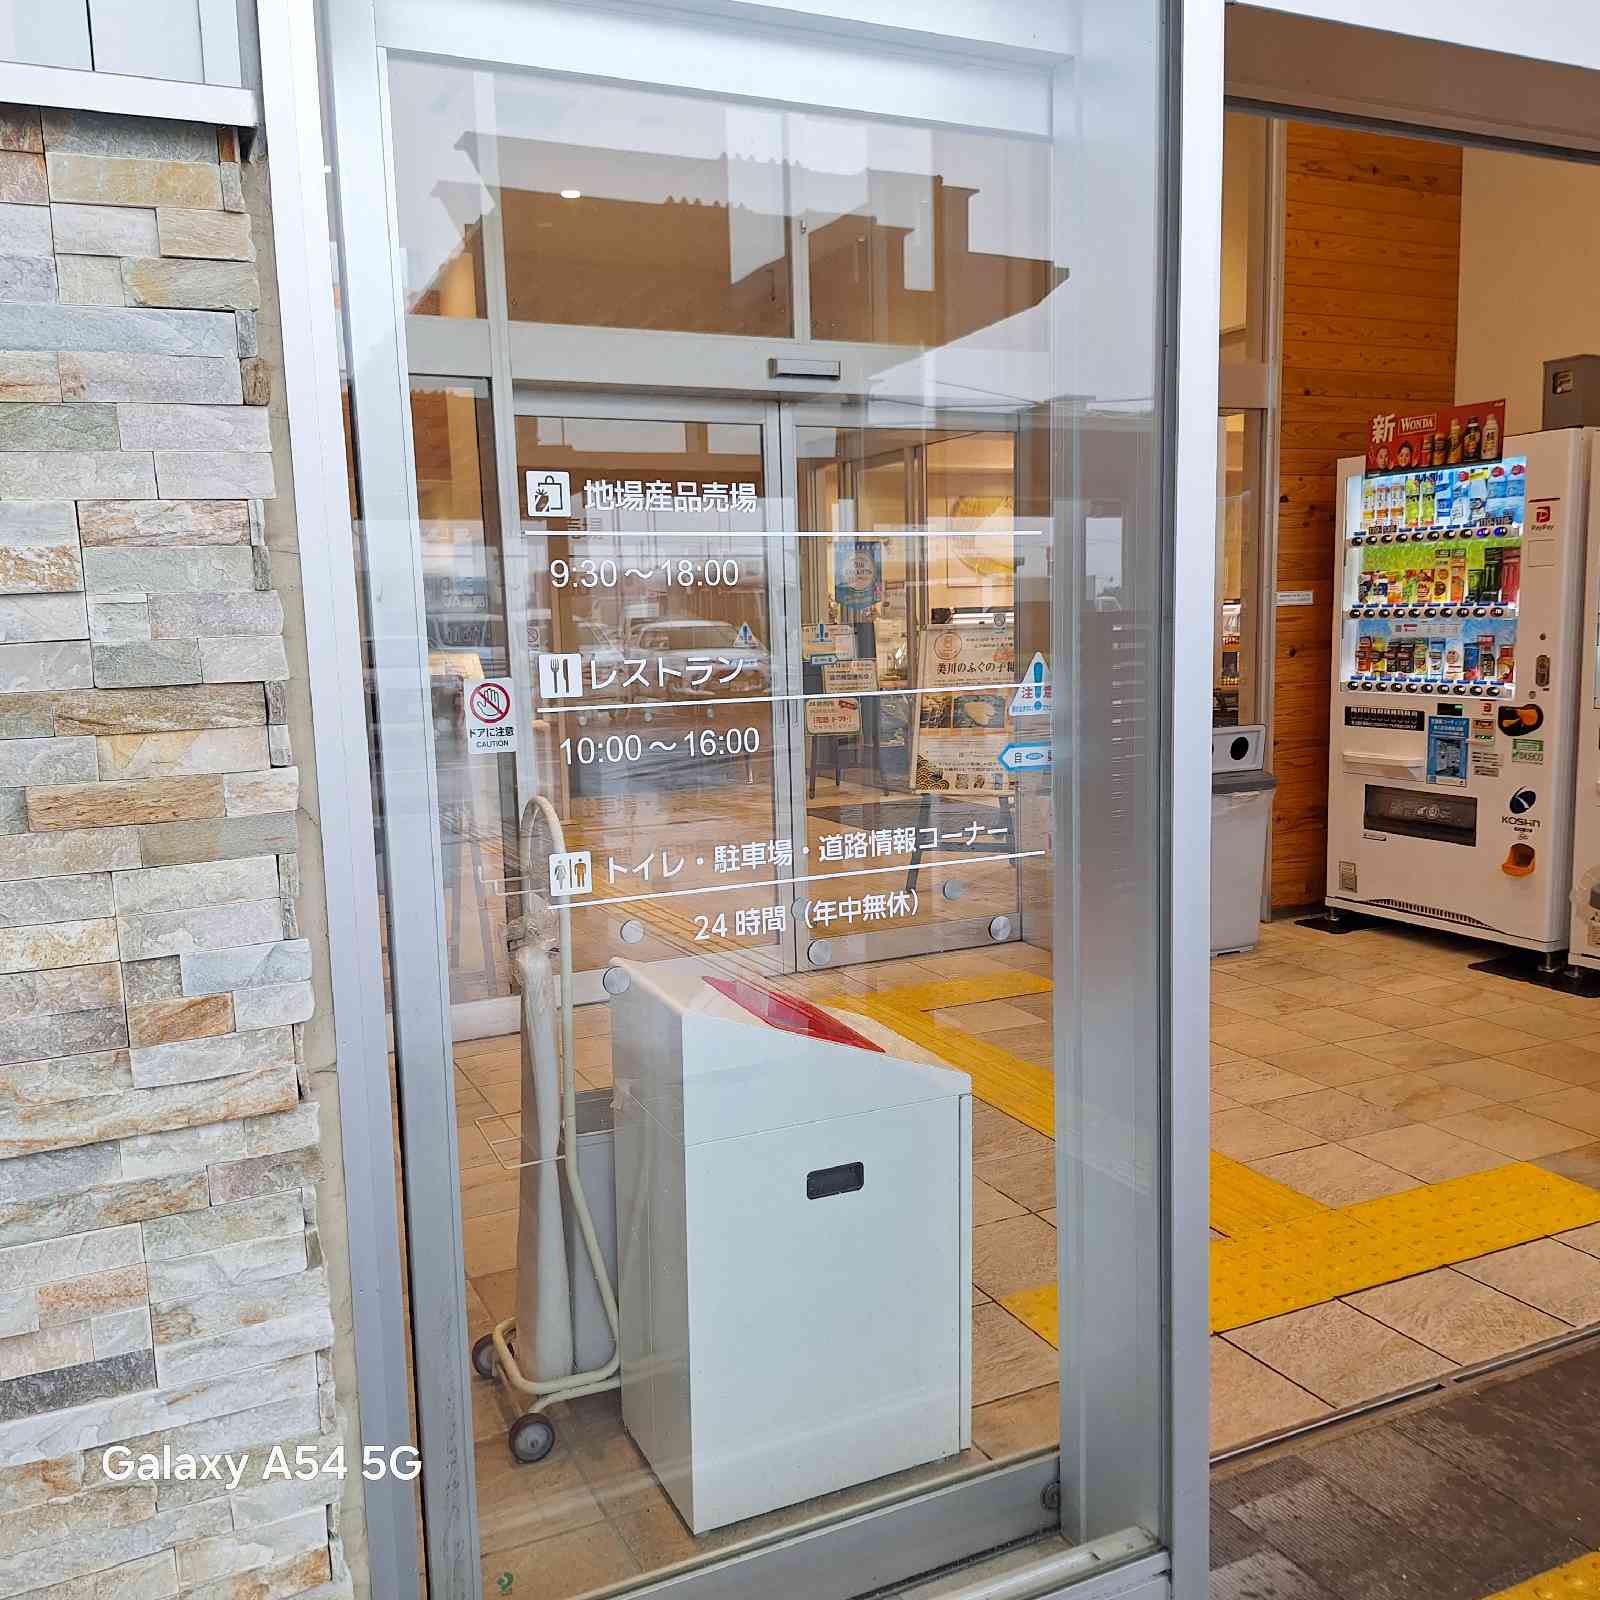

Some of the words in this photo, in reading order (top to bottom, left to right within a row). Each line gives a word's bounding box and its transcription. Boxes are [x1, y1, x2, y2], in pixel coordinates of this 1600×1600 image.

[1371, 414, 1396, 444] 新
[584, 479, 758, 513] 地場産品売場
[590, 656, 744, 690] レストラン
[470, 726, 514, 738] ドアに注意
[476, 740, 509, 748] CAUTION
